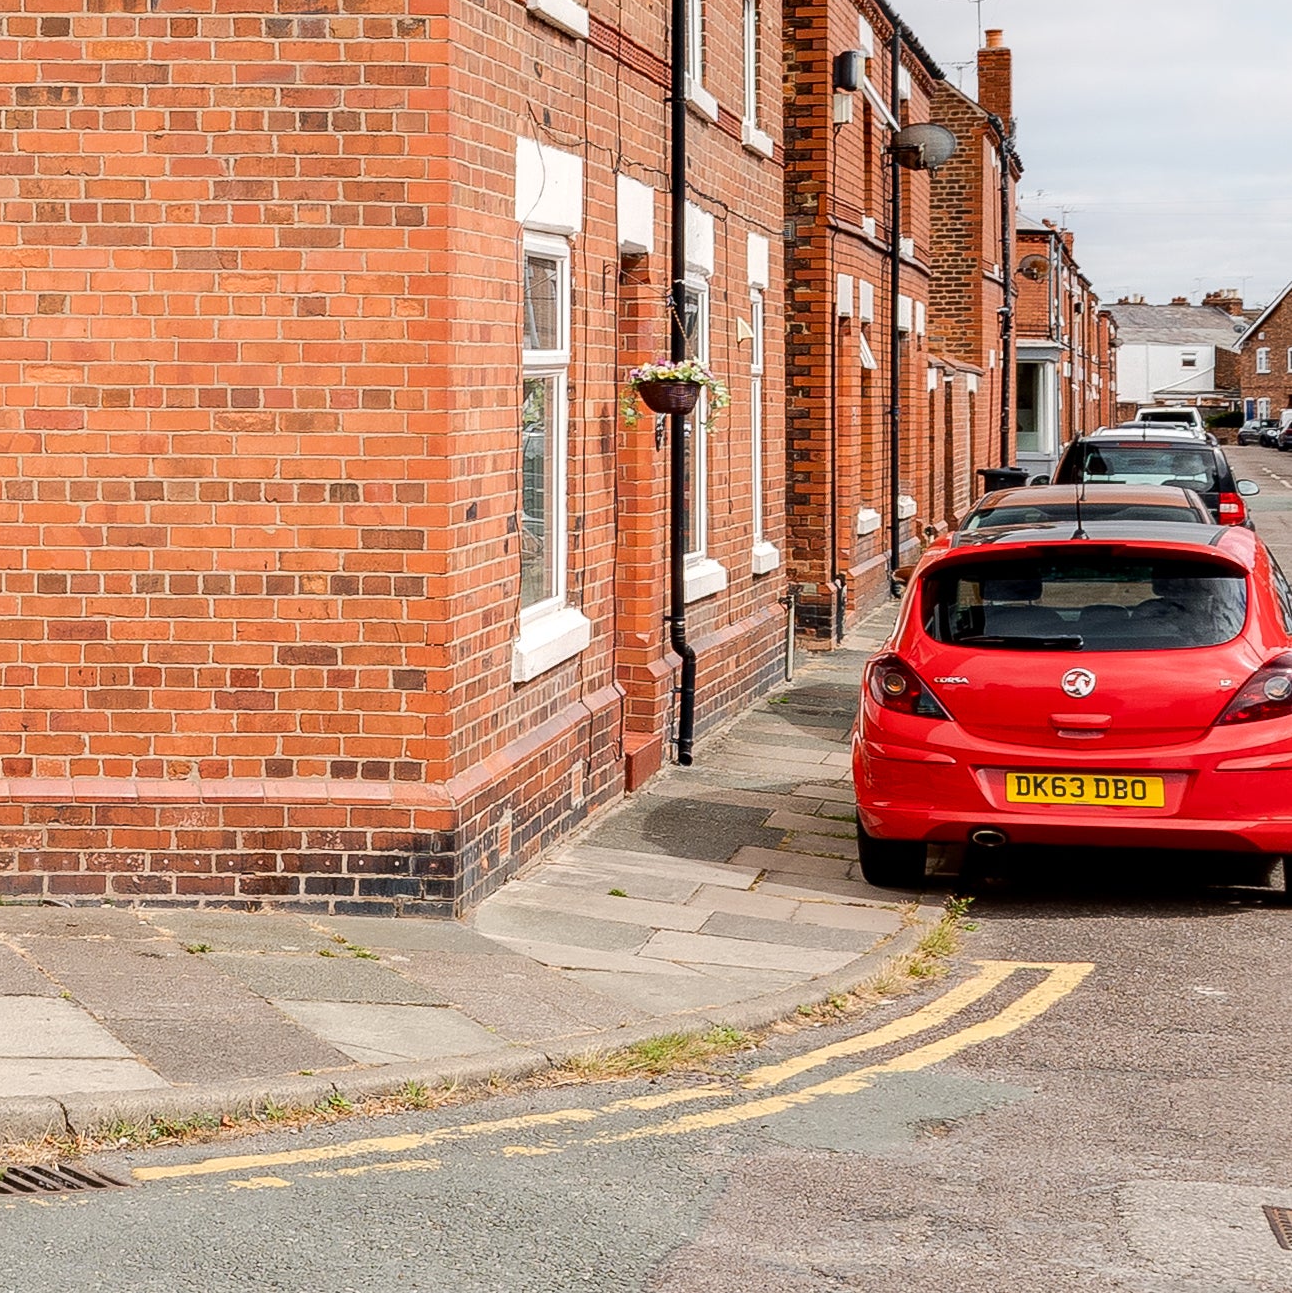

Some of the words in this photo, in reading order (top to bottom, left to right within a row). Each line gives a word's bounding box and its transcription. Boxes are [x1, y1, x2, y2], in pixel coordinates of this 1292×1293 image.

[933, 676, 970, 685] CORSA
[1015, 775, 1085, 798] DK63
[1093, 777, 1147, 801] DBO
